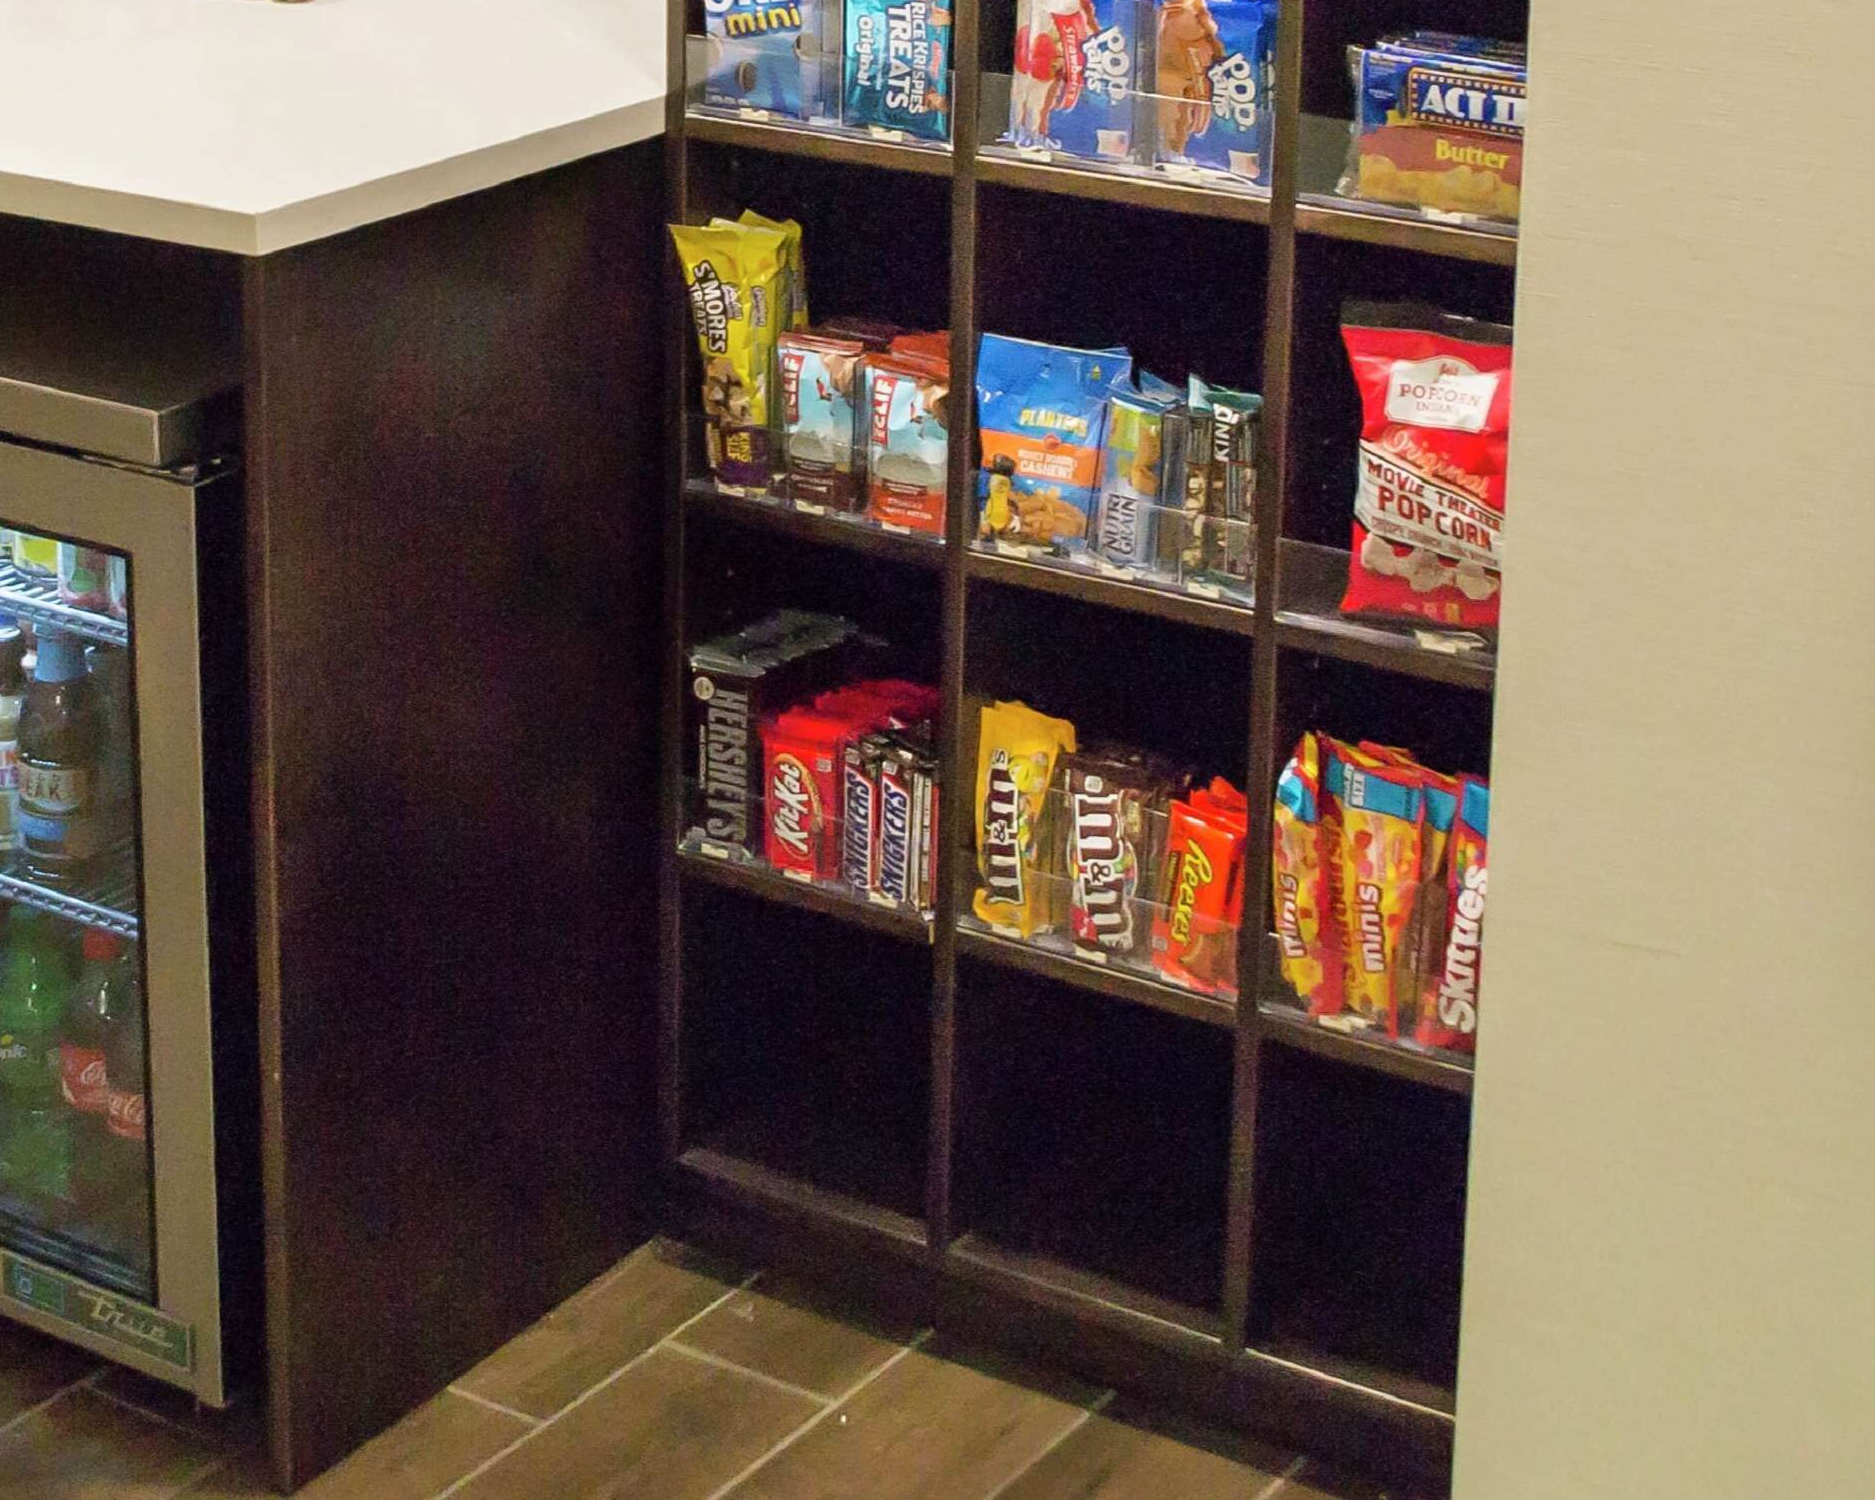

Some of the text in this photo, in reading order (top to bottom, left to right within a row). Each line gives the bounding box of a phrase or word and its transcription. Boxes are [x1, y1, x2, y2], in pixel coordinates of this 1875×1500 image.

[725, 2, 802, 38] mini
[855, 16, 876, 86] Original
[885, 3, 911, 109] TREATS
[909, 1, 928, 114] RICE KRISPIES
[1421, 83, 1488, 122] ACT
[1434, 137, 1511, 170] Butter
[693, 260, 727, 354] S'MORES
[1212, 403, 1235, 463] KIND
[1366, 457, 1503, 533] MOVIE THEATER
[1376, 484, 1493, 552] POPCORN
[706, 688, 750, 845] HERSHEY'S
[843, 769, 873, 890] SNICKERS
[880, 777, 909, 902] SNICKERS
[1357, 882, 1386, 974] minis
